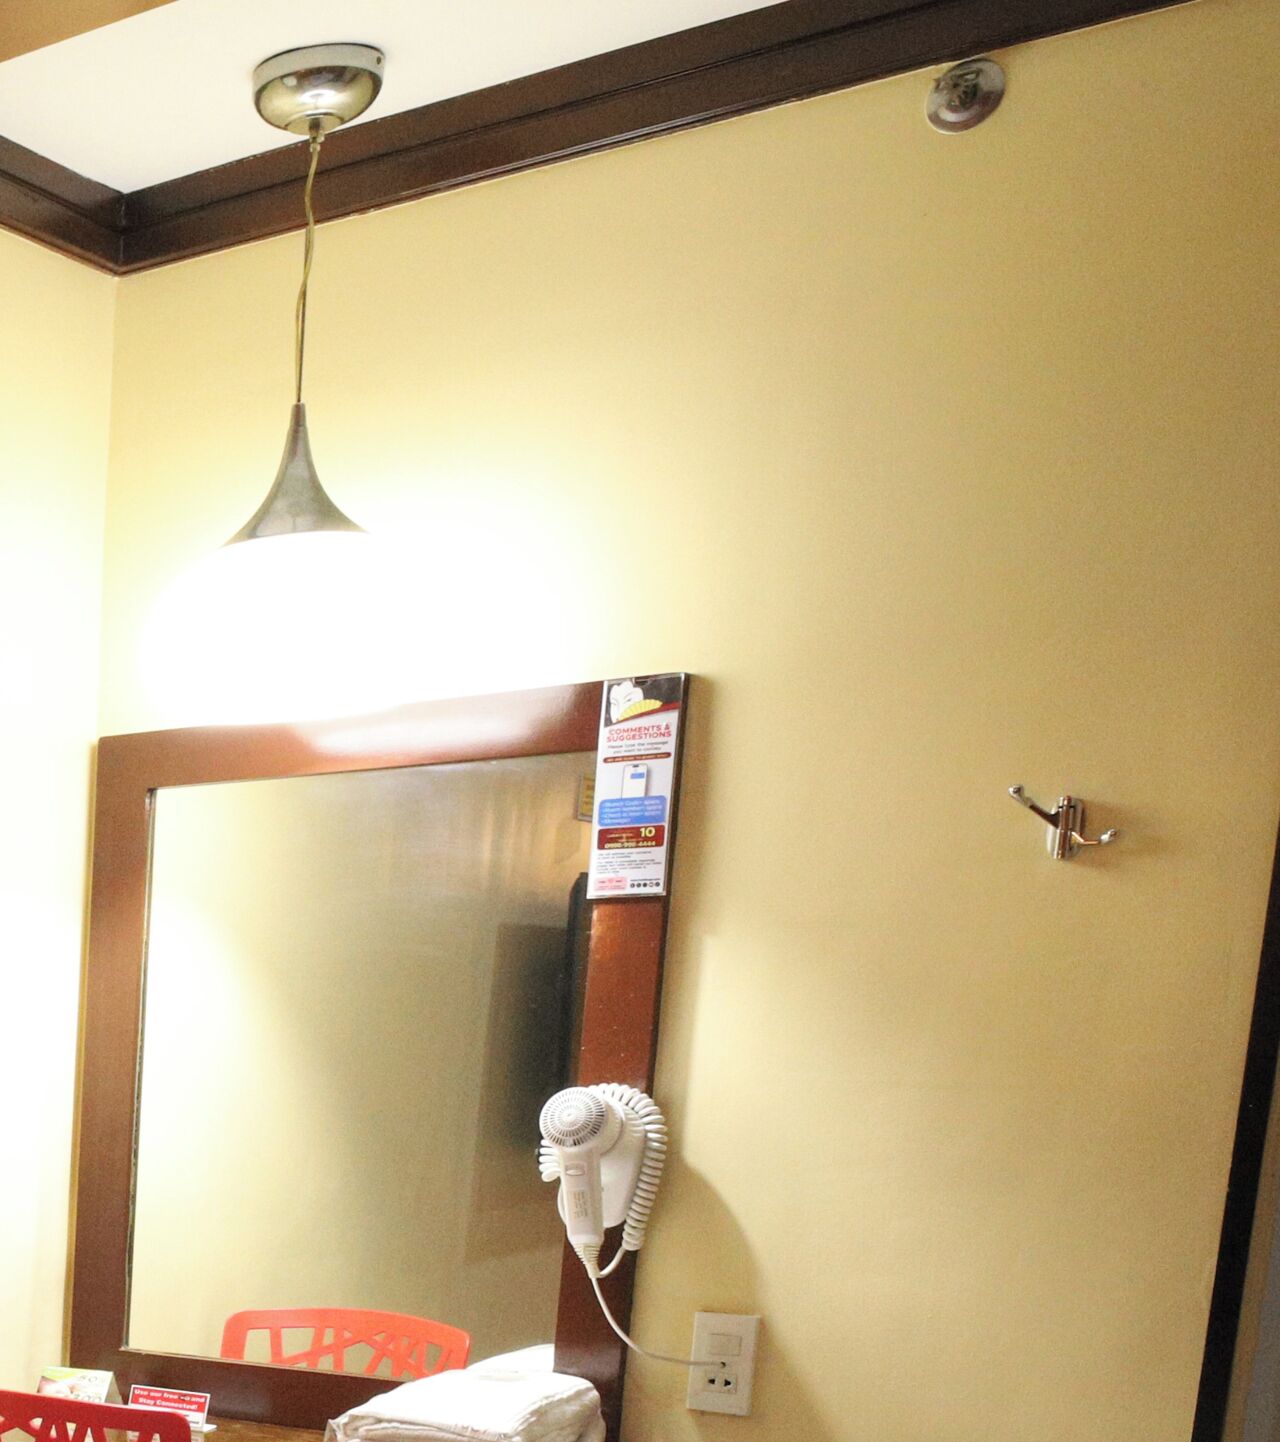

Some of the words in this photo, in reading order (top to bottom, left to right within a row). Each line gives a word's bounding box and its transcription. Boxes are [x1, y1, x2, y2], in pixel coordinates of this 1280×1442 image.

[609, 724, 662, 736] COMMENTS
[607, 730, 672, 743] SUGGESTIONS
[640, 827, 656, 838] 10
[138, 1397, 155, 1406] Stay
